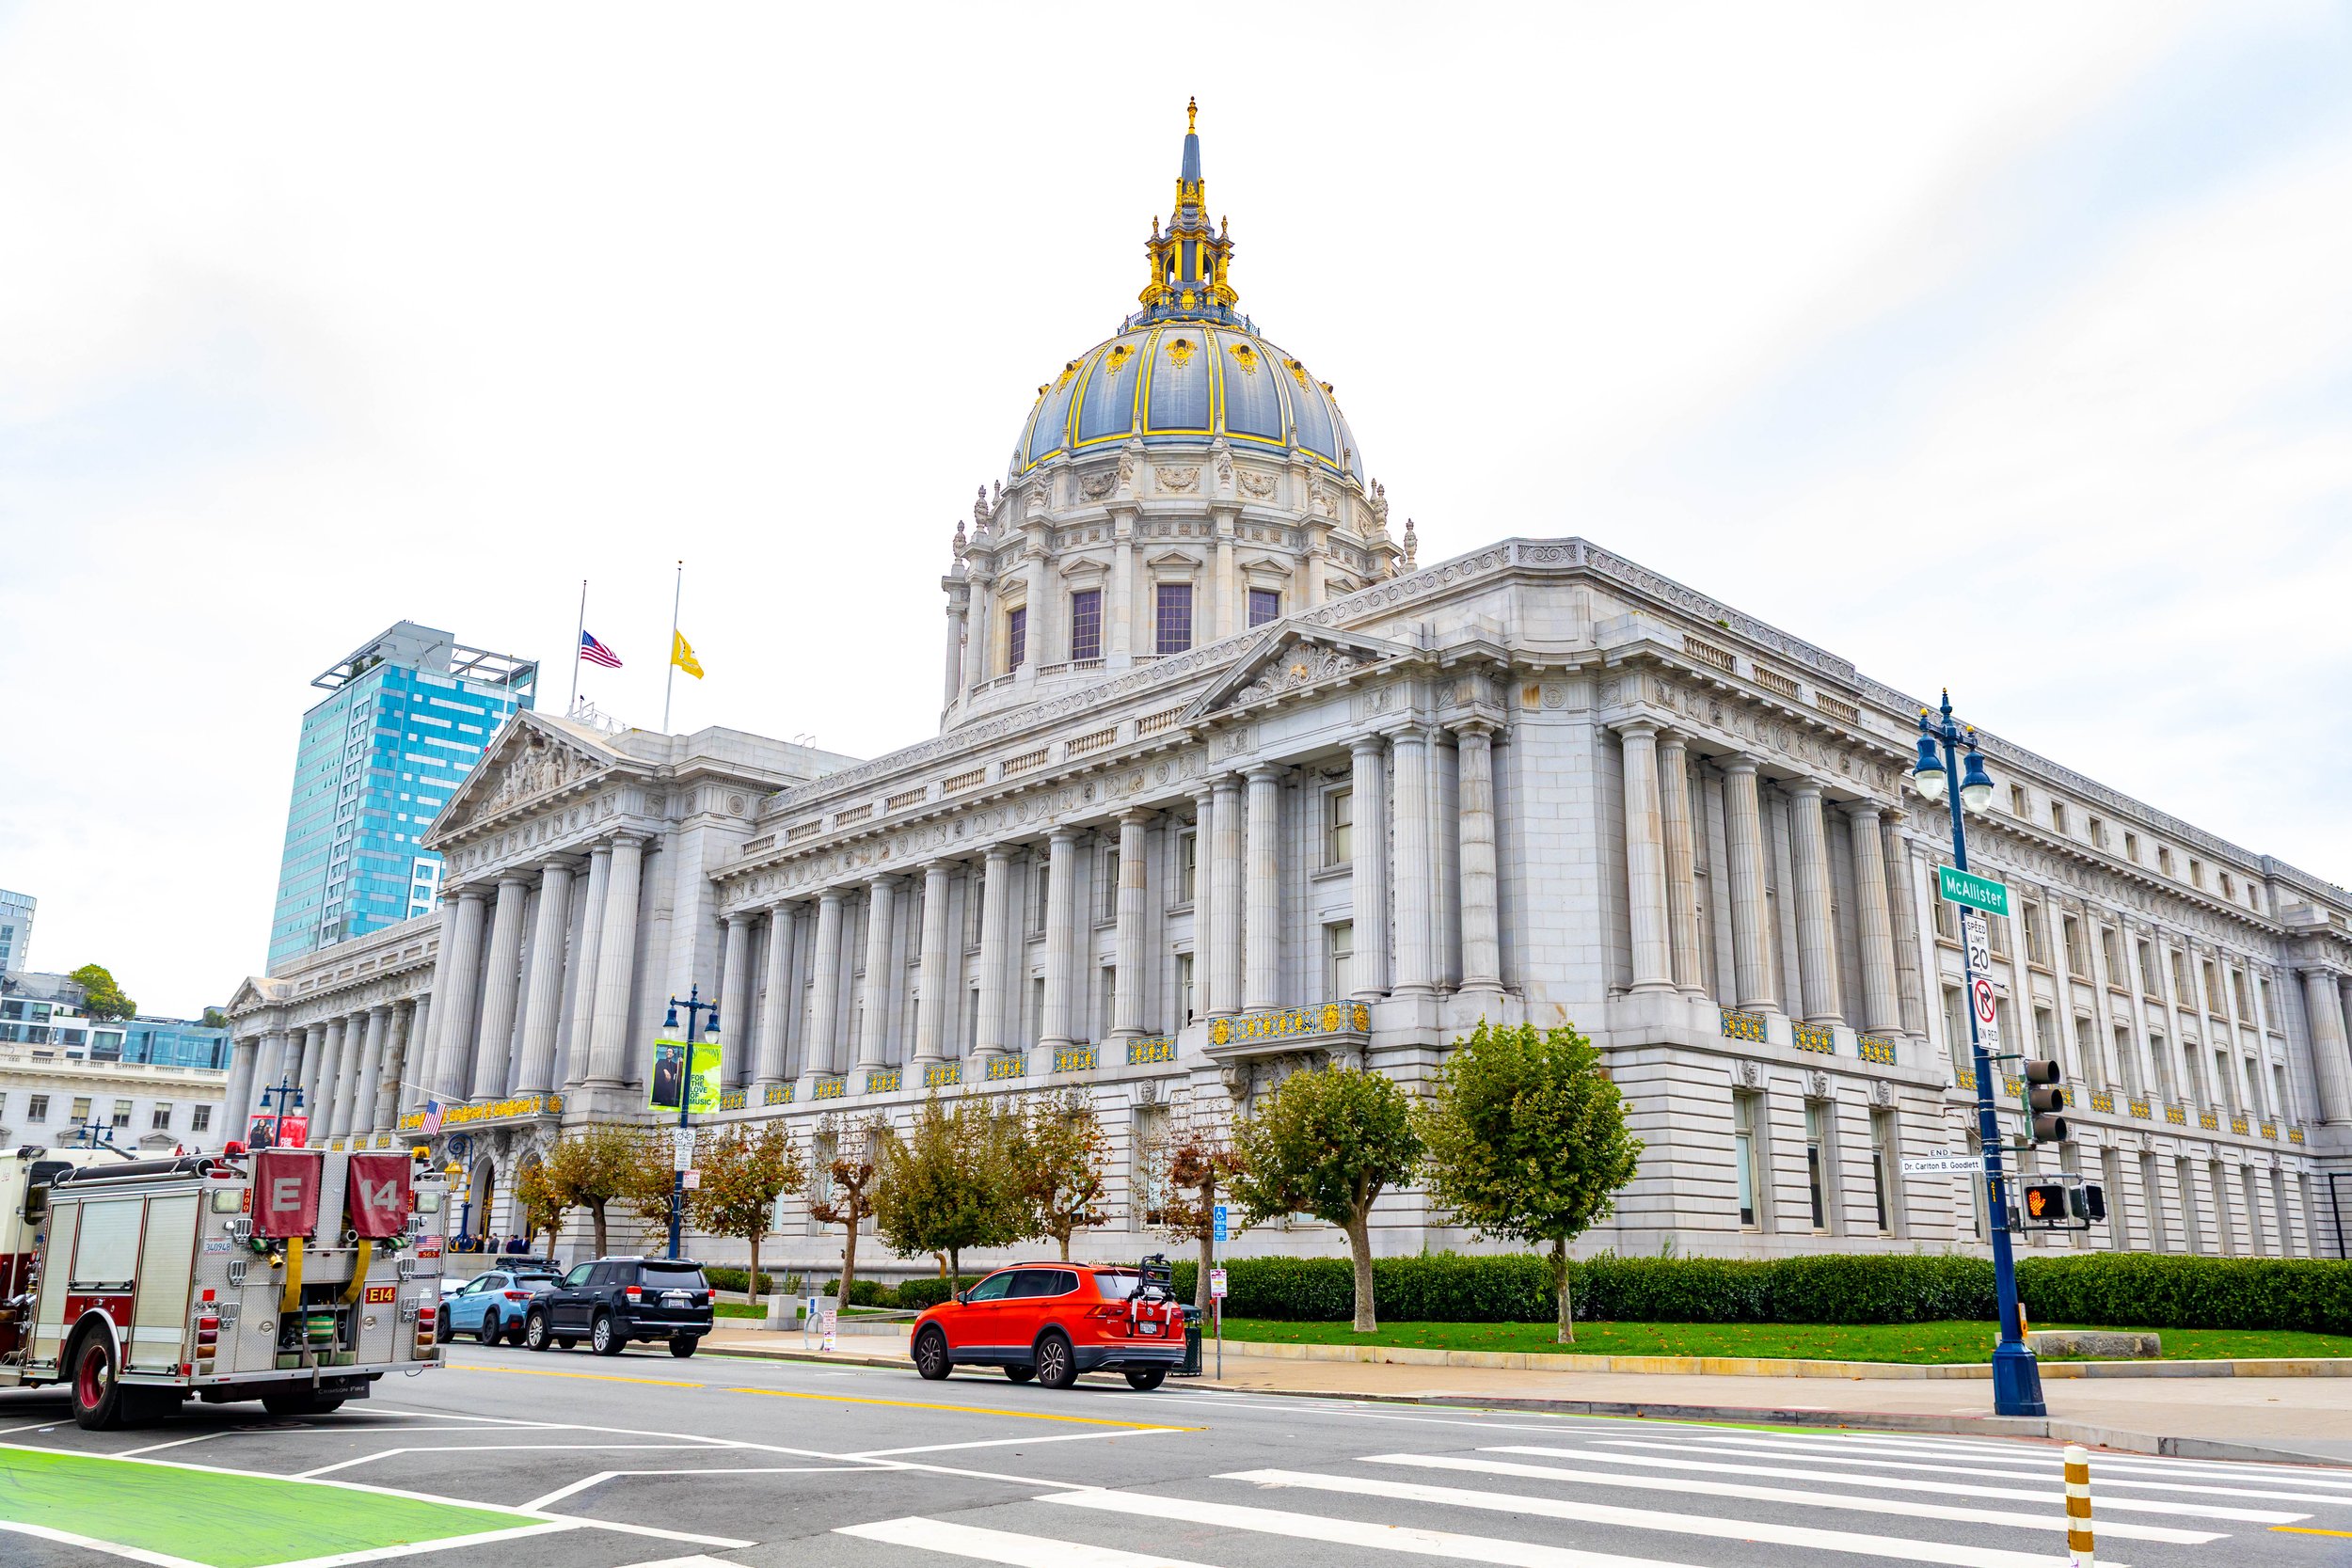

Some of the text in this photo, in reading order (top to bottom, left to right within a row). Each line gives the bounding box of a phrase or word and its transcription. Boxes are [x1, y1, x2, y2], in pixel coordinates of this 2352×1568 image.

[1946, 875, 2002, 907] McAllister
[1966, 922, 1986, 935] SPEED
[1970, 934, 1985, 944] LIMIT
[1971, 946, 1989, 970] 20
[1979, 1027, 1997, 1041] ON RED
[1904, 1163, 1914, 1171] Dr.
[1949, 1161, 1979, 1169] Goodlett
[272, 1178, 301, 1212] E
[360, 1179, 400, 1212] 14
[369, 1289, 393, 1302] E14
[317, 1386, 349, 1395] CRIMSON
